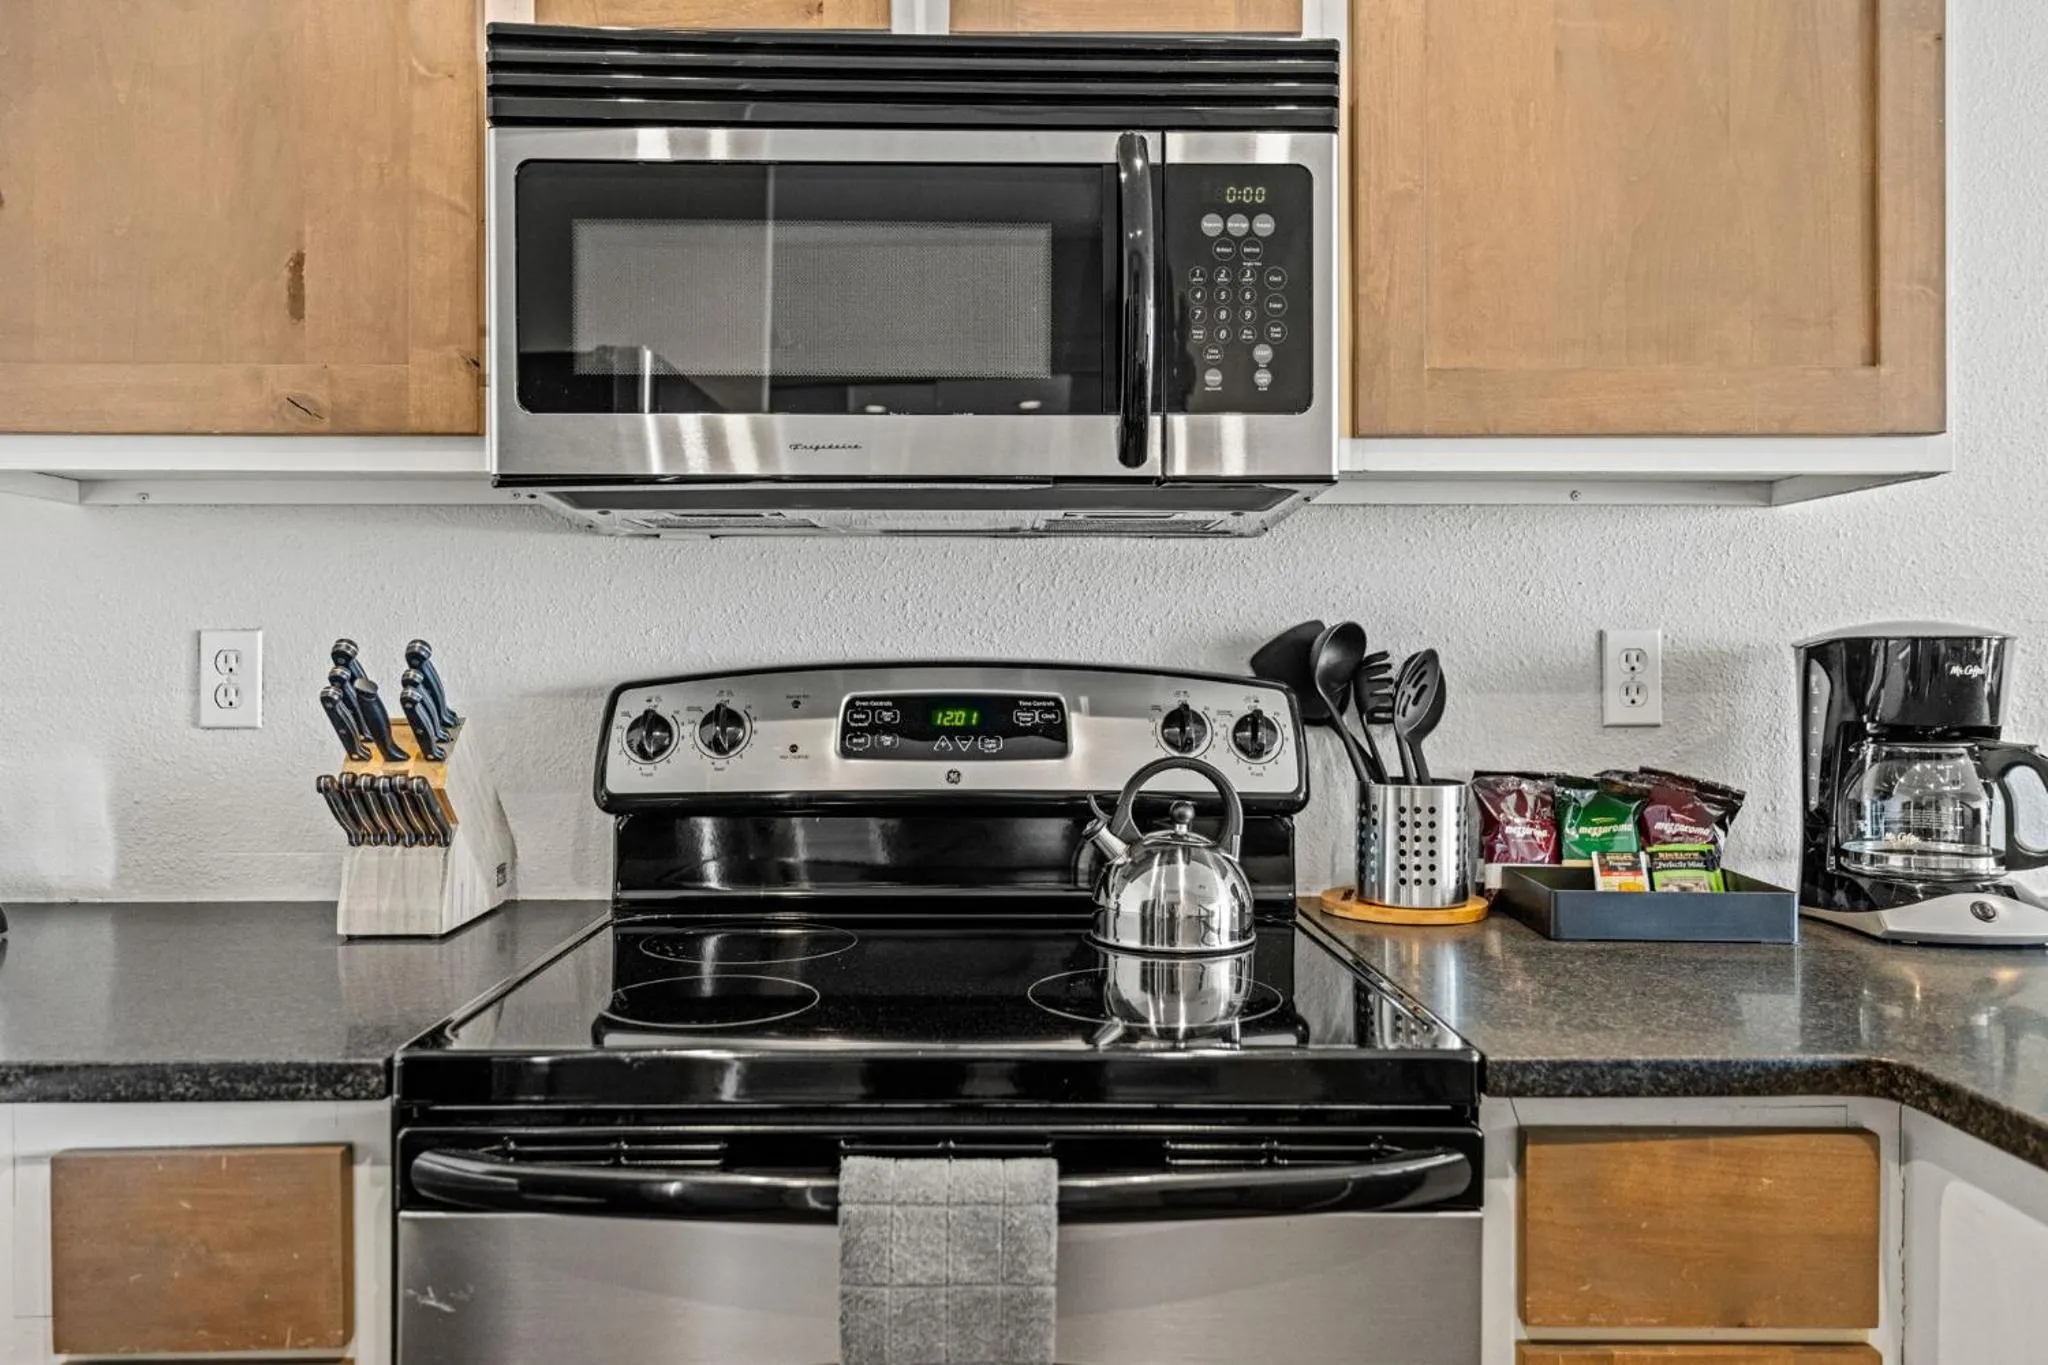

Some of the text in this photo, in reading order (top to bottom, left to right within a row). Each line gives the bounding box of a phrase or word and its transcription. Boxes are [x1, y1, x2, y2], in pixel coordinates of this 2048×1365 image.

[1227, 186, 1266, 204] 0:00
[1195, 269, 1200, 277] 1
[1220, 269, 1226, 277] 2
[1245, 269, 1251, 277] 3
[1195, 291, 1202, 299] 4
[1220, 291, 1226, 300] 5
[1244, 291, 1251, 300] 6
[1194, 310, 1202, 319] 7
[1219, 310, 1226, 320] 8
[1244, 310, 1252, 320] 9
[1219, 329, 1227, 339] 0
